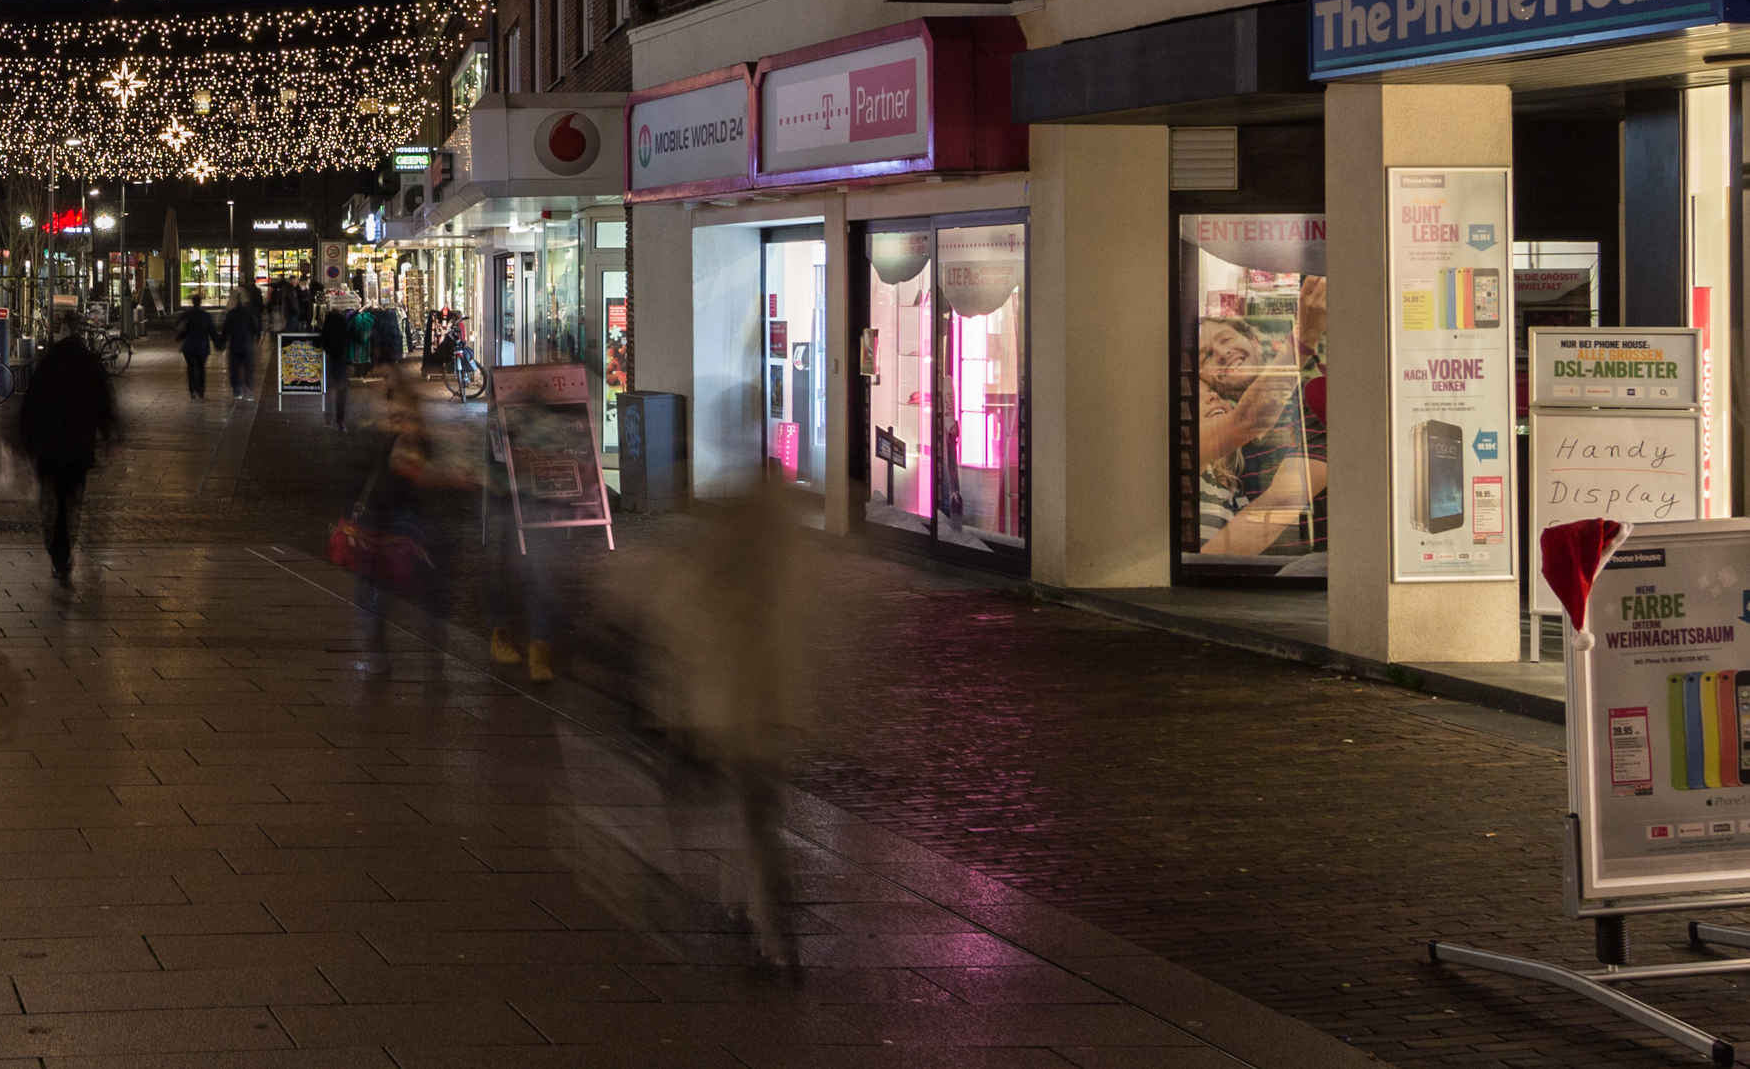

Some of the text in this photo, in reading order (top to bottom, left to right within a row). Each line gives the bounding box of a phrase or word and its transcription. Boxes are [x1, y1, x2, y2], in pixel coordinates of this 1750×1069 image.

[856, 86, 910, 125] Partner
[655, 116, 743, 154] MOBILE WORLD 24
[395, 155, 429, 165] GEERS
[1402, 205, 1441, 224] BUNT
[1197, 220, 1326, 241] ENTERTAIN
[1412, 224, 1459, 242] LEBEN
[948, 267, 980, 286] LTE Plus
[1525, 273, 1538, 281] DIE
[1541, 272, 1579, 281] GRÖSSTE
[1560, 340, 1650, 349] NUR BEI PHONE HOUSE:
[1577, 349, 1663, 361] ALLE GROSSEN
[1404, 359, 1484, 380] NACH VORNE
[1554, 360, 1678, 379] DSL-ANBIETER
[1432, 381, 1466, 391] DENKEN
[1556, 438, 1675, 468] Handy
[1548, 480, 1680, 518] Display
[1635, 553, 1661, 562] House
[1635, 586, 1655, 594] MEHR
[1621, 593, 1686, 620] FARBE
[1632, 620, 1661, 630] UNTERM
[1606, 625, 1734, 649] WEIHNACHTSBAUM
[1677, 655, 1696, 663] BESTEN
[1612, 726, 1633, 736] 39.95
